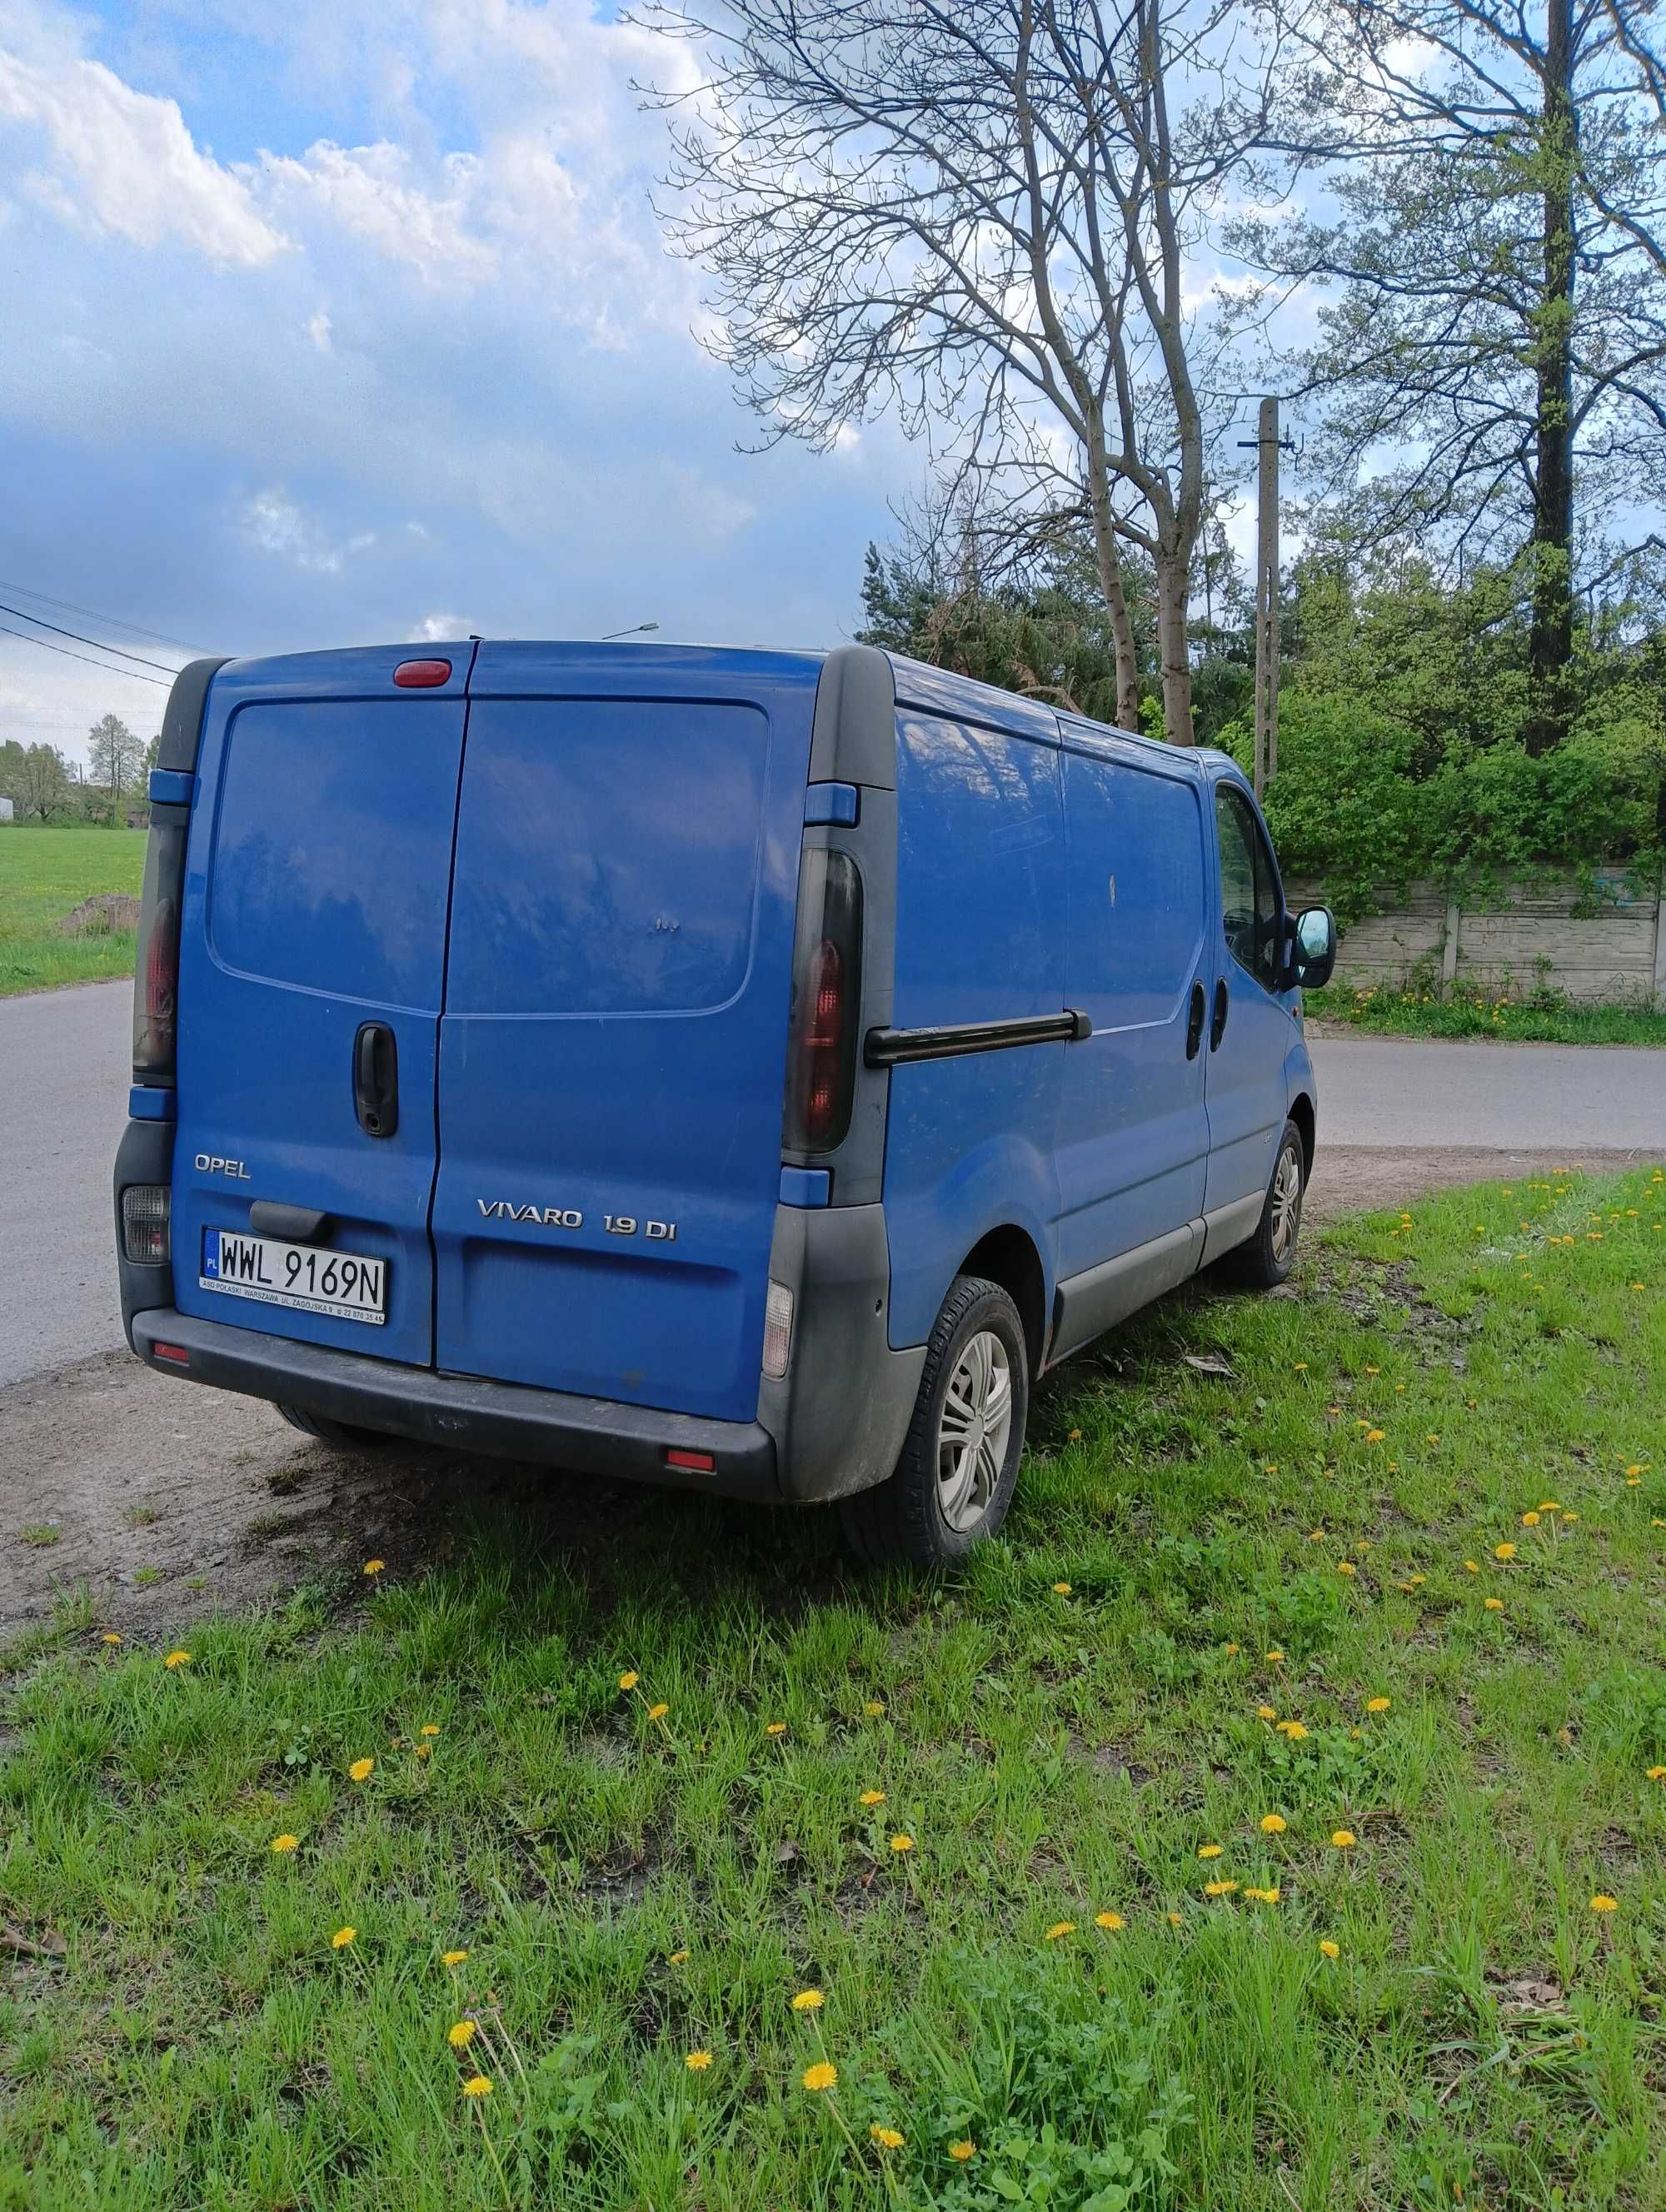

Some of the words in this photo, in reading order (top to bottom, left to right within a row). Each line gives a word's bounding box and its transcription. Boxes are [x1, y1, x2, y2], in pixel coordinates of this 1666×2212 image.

[194, 1153, 252, 1180] OPEL
[477, 1198, 584, 1228] VIVARO
[603, 1215, 638, 1234] 1.9
[646, 1221, 676, 1240] DI
[207, 1258, 218, 1269] PL
[222, 1238, 272, 1284] WWL
[285, 1250, 379, 1304] 9169N
[244, 1288, 278, 1302] WARSZAWA
